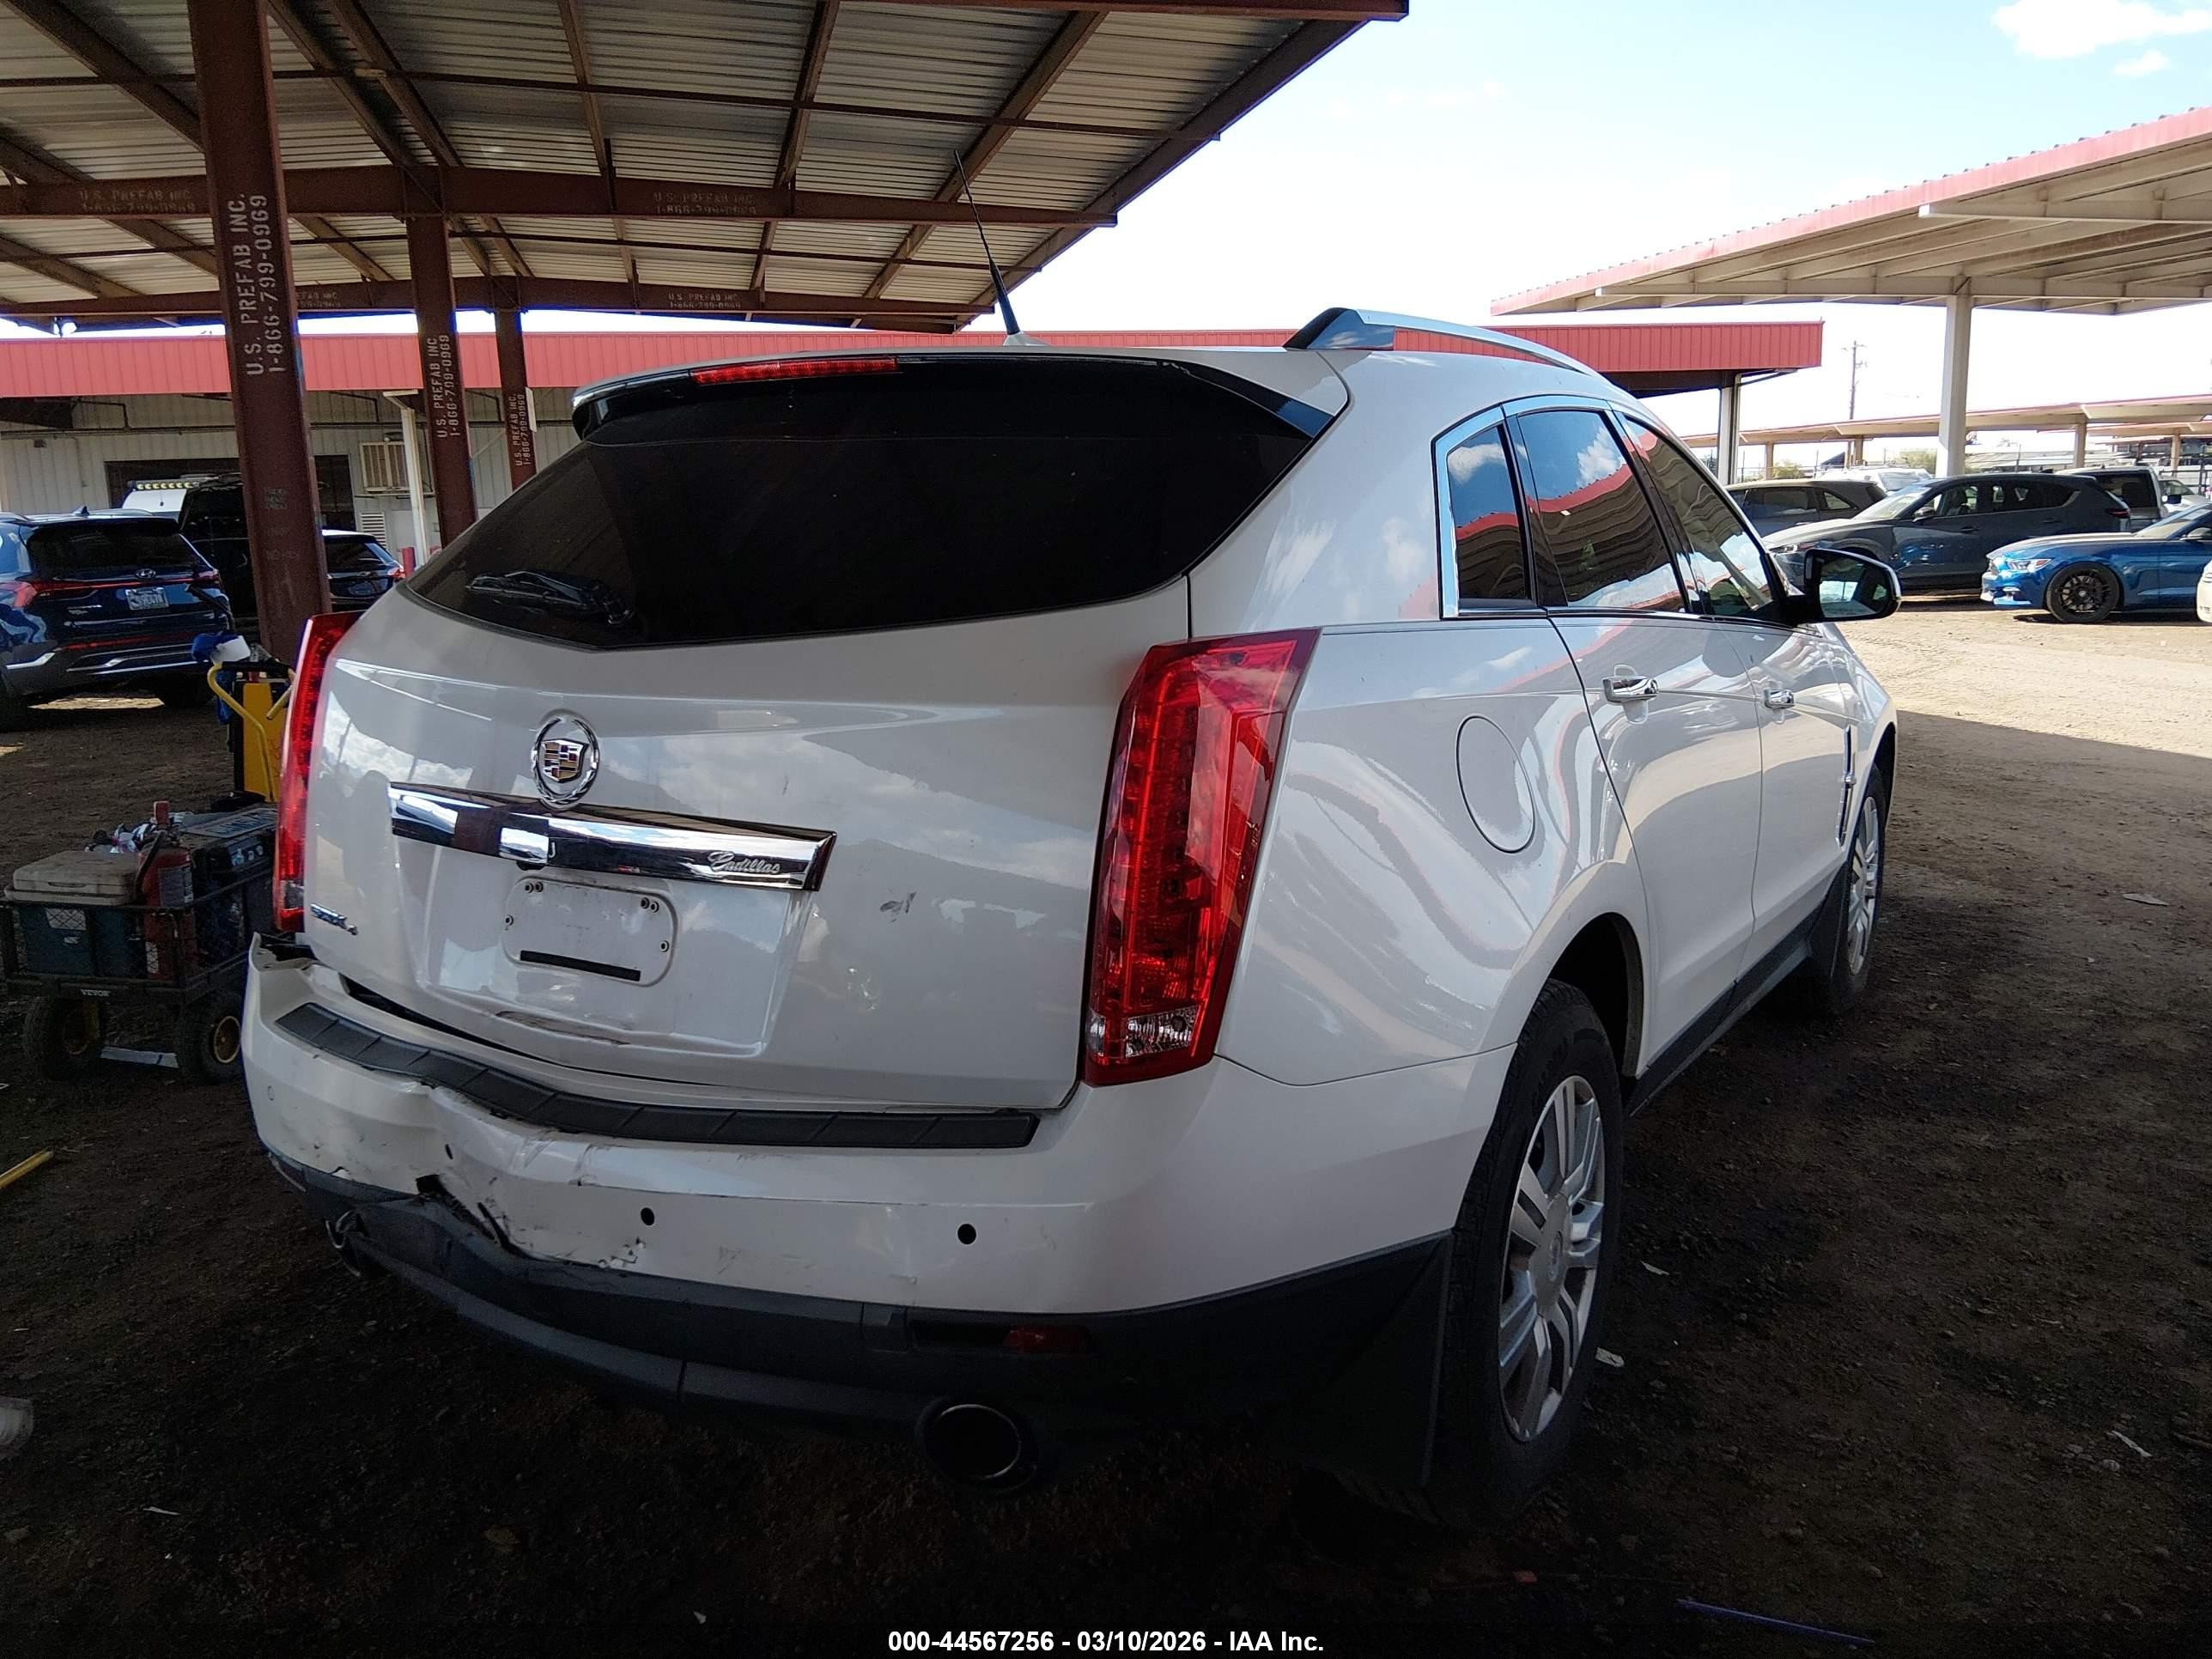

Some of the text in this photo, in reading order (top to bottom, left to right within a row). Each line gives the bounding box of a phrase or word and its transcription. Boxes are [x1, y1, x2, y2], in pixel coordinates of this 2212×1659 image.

[228, 193, 264, 375] U.S. PREFAB INC.
[249, 195, 287, 372] 1-866-799-0969
[429, 362, 446, 409] PREFAB
[510, 413, 520, 446] PREFAB
[708, 851, 781, 874] Cadillac
